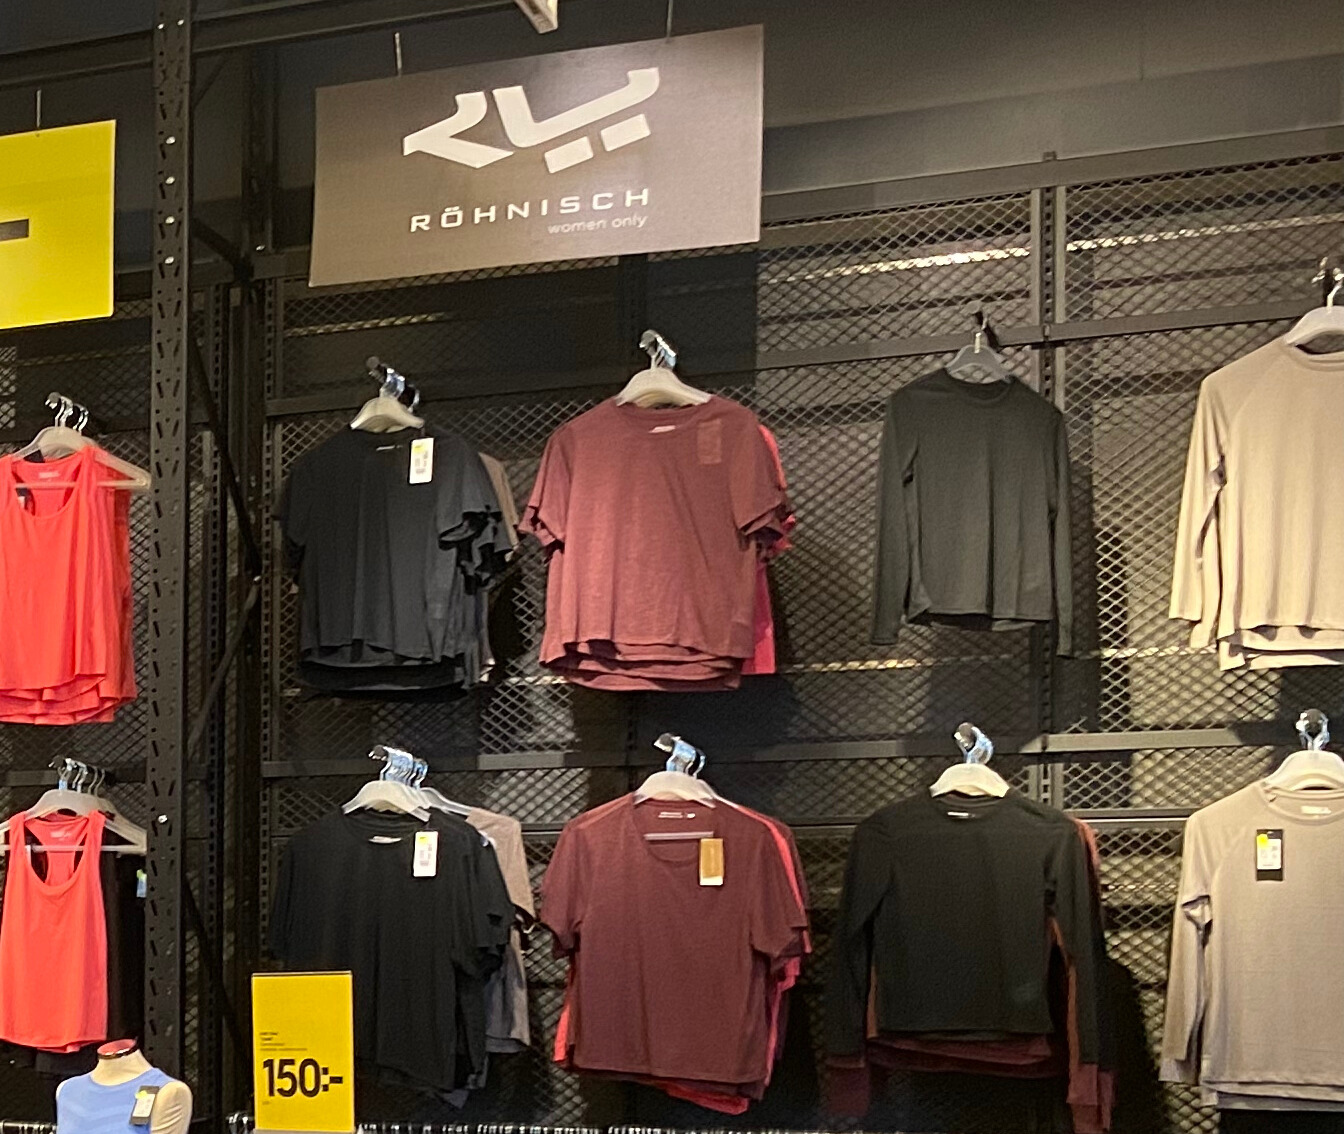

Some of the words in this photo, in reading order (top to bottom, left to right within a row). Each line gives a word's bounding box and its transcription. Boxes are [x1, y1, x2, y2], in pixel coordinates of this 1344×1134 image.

[409, 188, 650, 233] RÖHNISCH
[547, 219, 606, 235] women
[611, 214, 649, 229] only
[262, 1058, 344, 1098] 150:-
